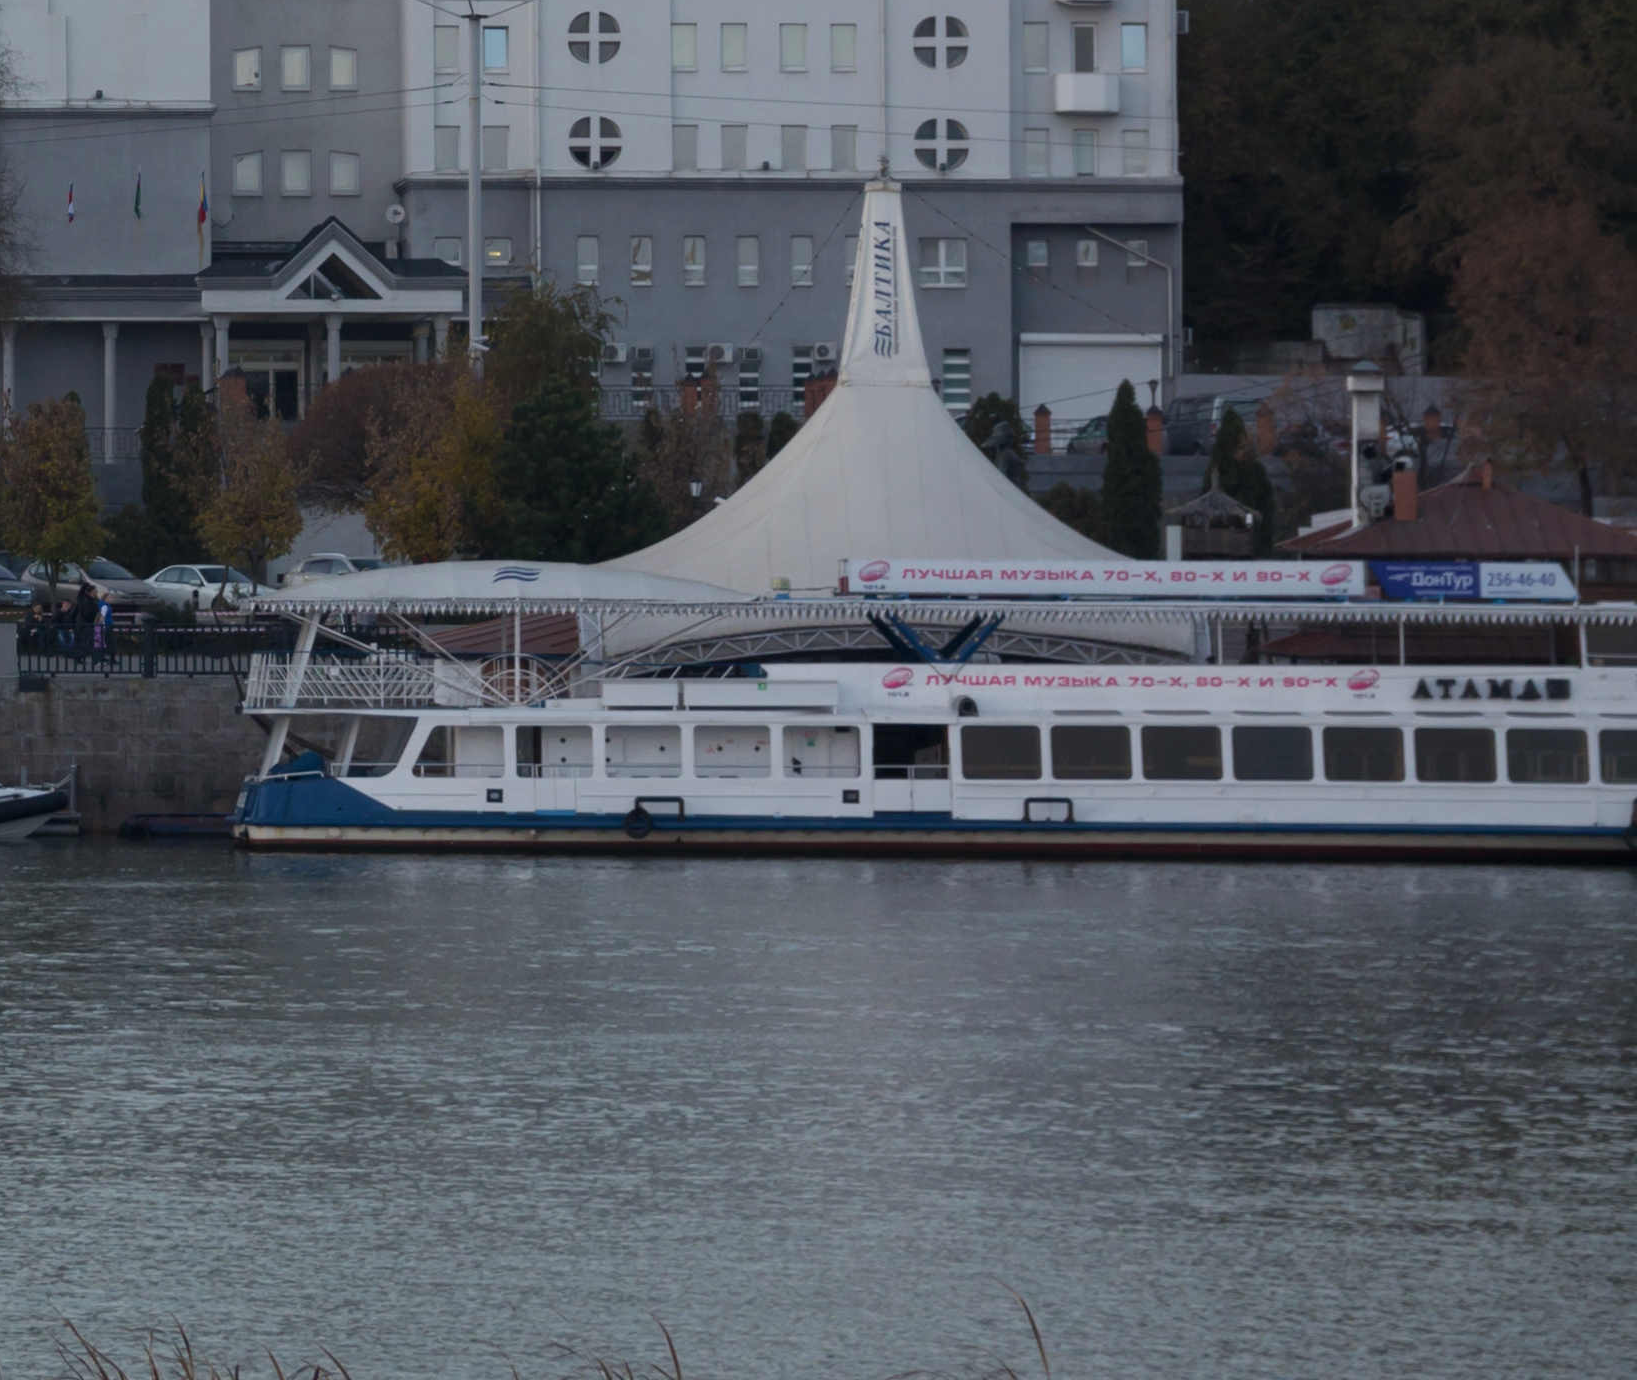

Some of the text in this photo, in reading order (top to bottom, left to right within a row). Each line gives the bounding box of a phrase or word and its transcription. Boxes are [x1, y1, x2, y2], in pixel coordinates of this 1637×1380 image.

[874, 221, 892, 337] БАЛТИКА
[902, 568, 993, 580] ЛУЧШАЯ
[1000, 569, 1095, 581] МУЗЫКА
[1233, 572, 1247, 582] И
[1411, 572, 1474, 590] ДонТур
[1486, 572, 1557, 587] 256-46-40
[926, 674, 1017, 687] ЛУЧШАЯ
[1024, 676, 1119, 688] МУЗЫКА
[1260, 677, 1274, 688] И
